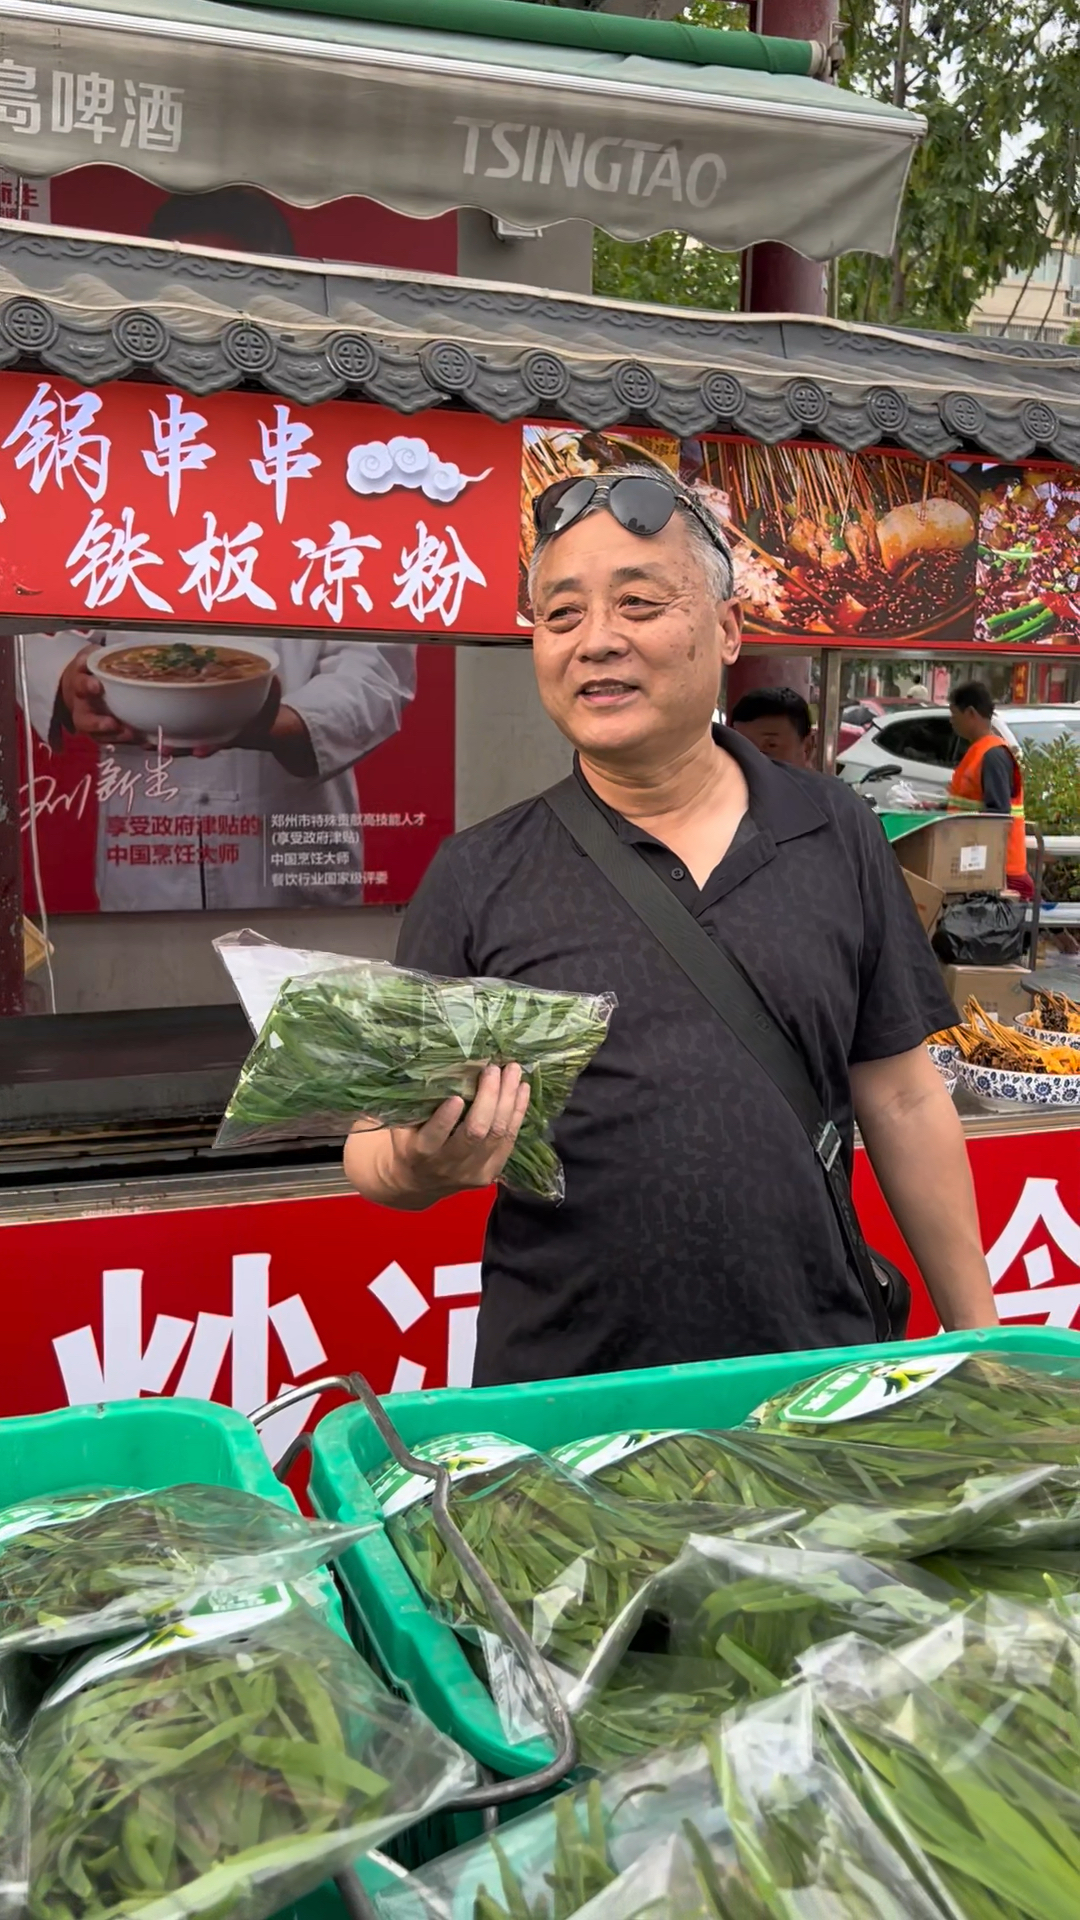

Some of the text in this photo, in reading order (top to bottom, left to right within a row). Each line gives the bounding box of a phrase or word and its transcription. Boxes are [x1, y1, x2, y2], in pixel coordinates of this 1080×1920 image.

[453, 116, 727, 208] TSINGTAO
[1, 382, 322, 524] 锅串串
[65, 507, 487, 626] 铁板凉粉
[107, 815, 261, 836] 享受政府津贴的
[107, 844, 240, 866] 中国烹饪大师
[271, 852, 350, 866] 中国烹饪大师
